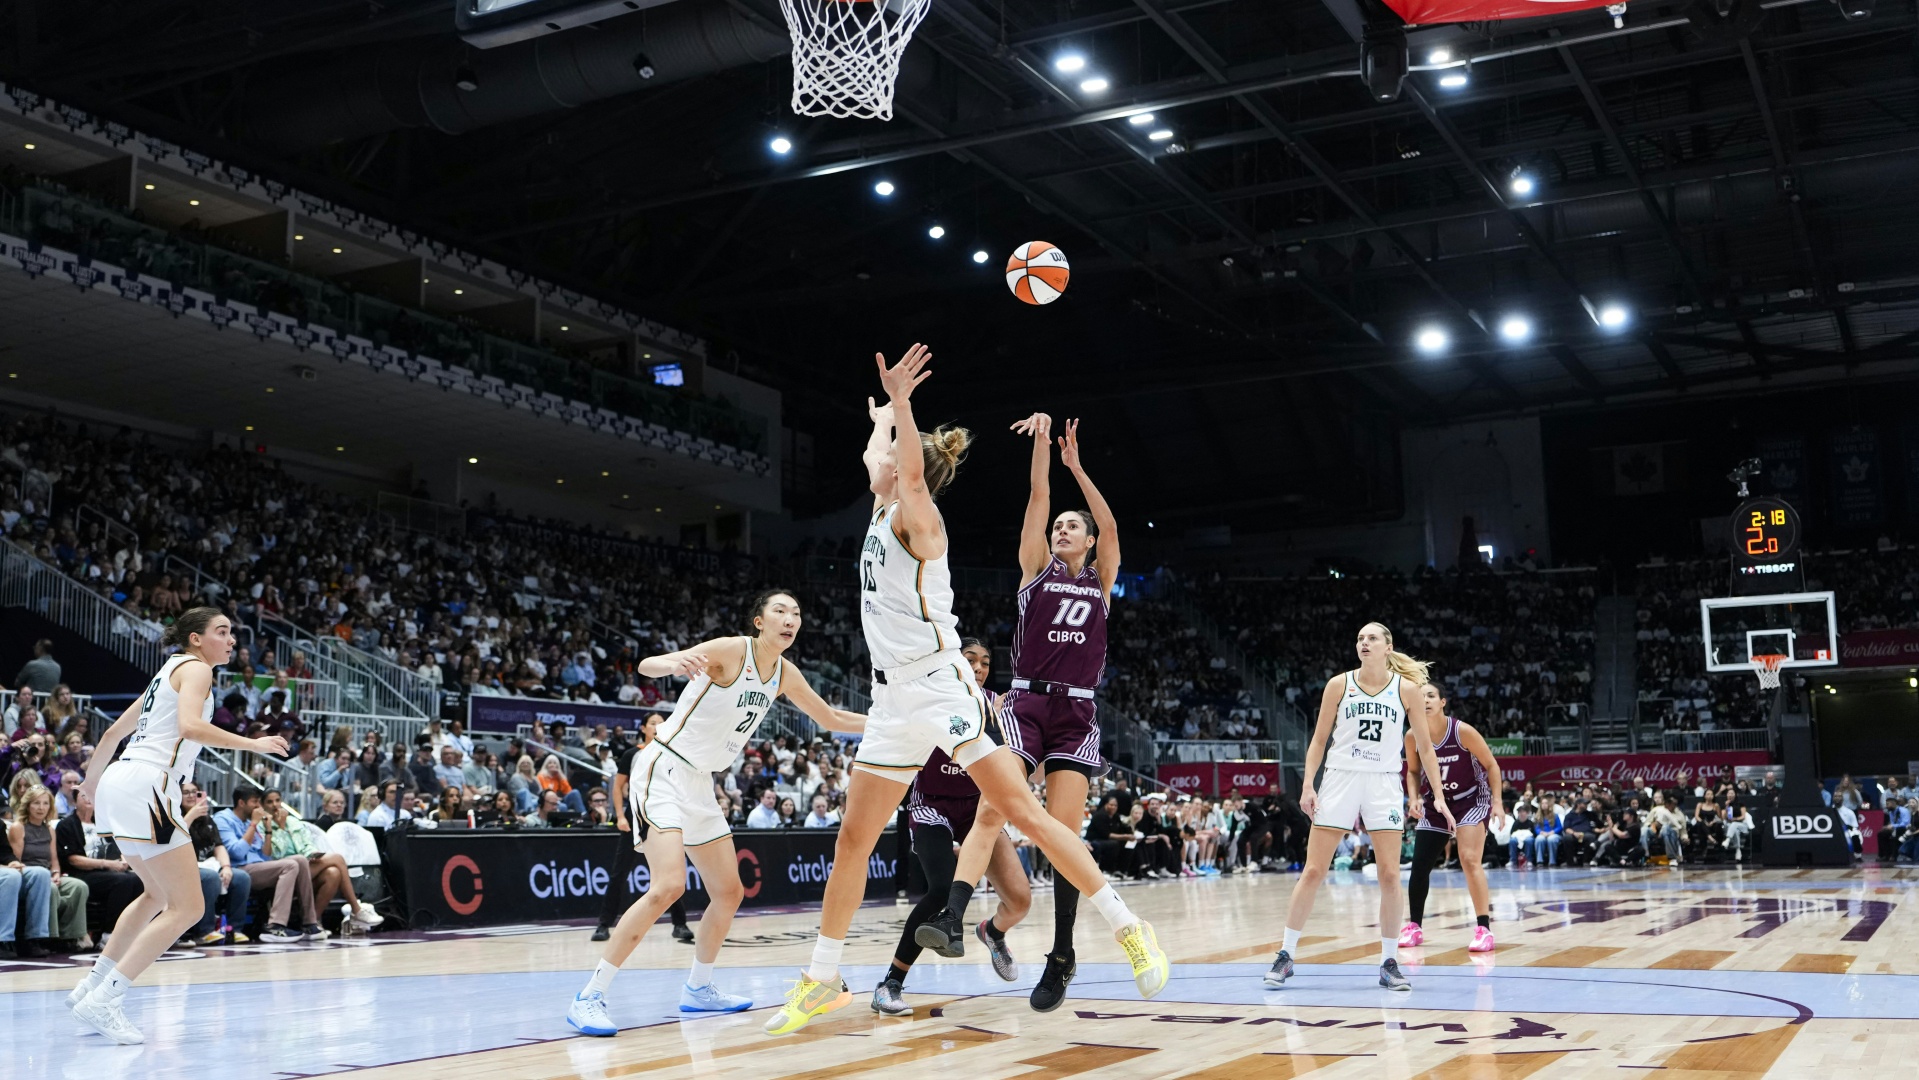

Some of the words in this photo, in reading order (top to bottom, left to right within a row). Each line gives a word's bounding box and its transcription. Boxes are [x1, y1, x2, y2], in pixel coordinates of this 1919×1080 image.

[14, 246, 55, 269] STRALMAN
[1050, 252, 1068, 262] Wil
[1751, 509, 1785, 527] 2:18
[1746, 527, 1778, 554] 2.0
[1042, 582, 1102, 599] TORONTO
[1052, 598, 1092, 626] 10
[535, 712, 576, 725] TEMPO
[735, 711, 757, 733] 21
[1358, 719, 1383, 742] 23
[1437, 754, 1460, 763] ONTO
[1232, 774, 1256, 786] CIBC
[1501, 769, 1526, 781] LUB
[1560, 767, 1590, 779] CIBC
[1608, 759, 1694, 784] Courtside
[1698, 765, 1722, 778] CLU
[1170, 776, 1191, 788] CIBC
[1780, 814, 1833, 834] BDO
[528, 859, 609, 899] Circle
